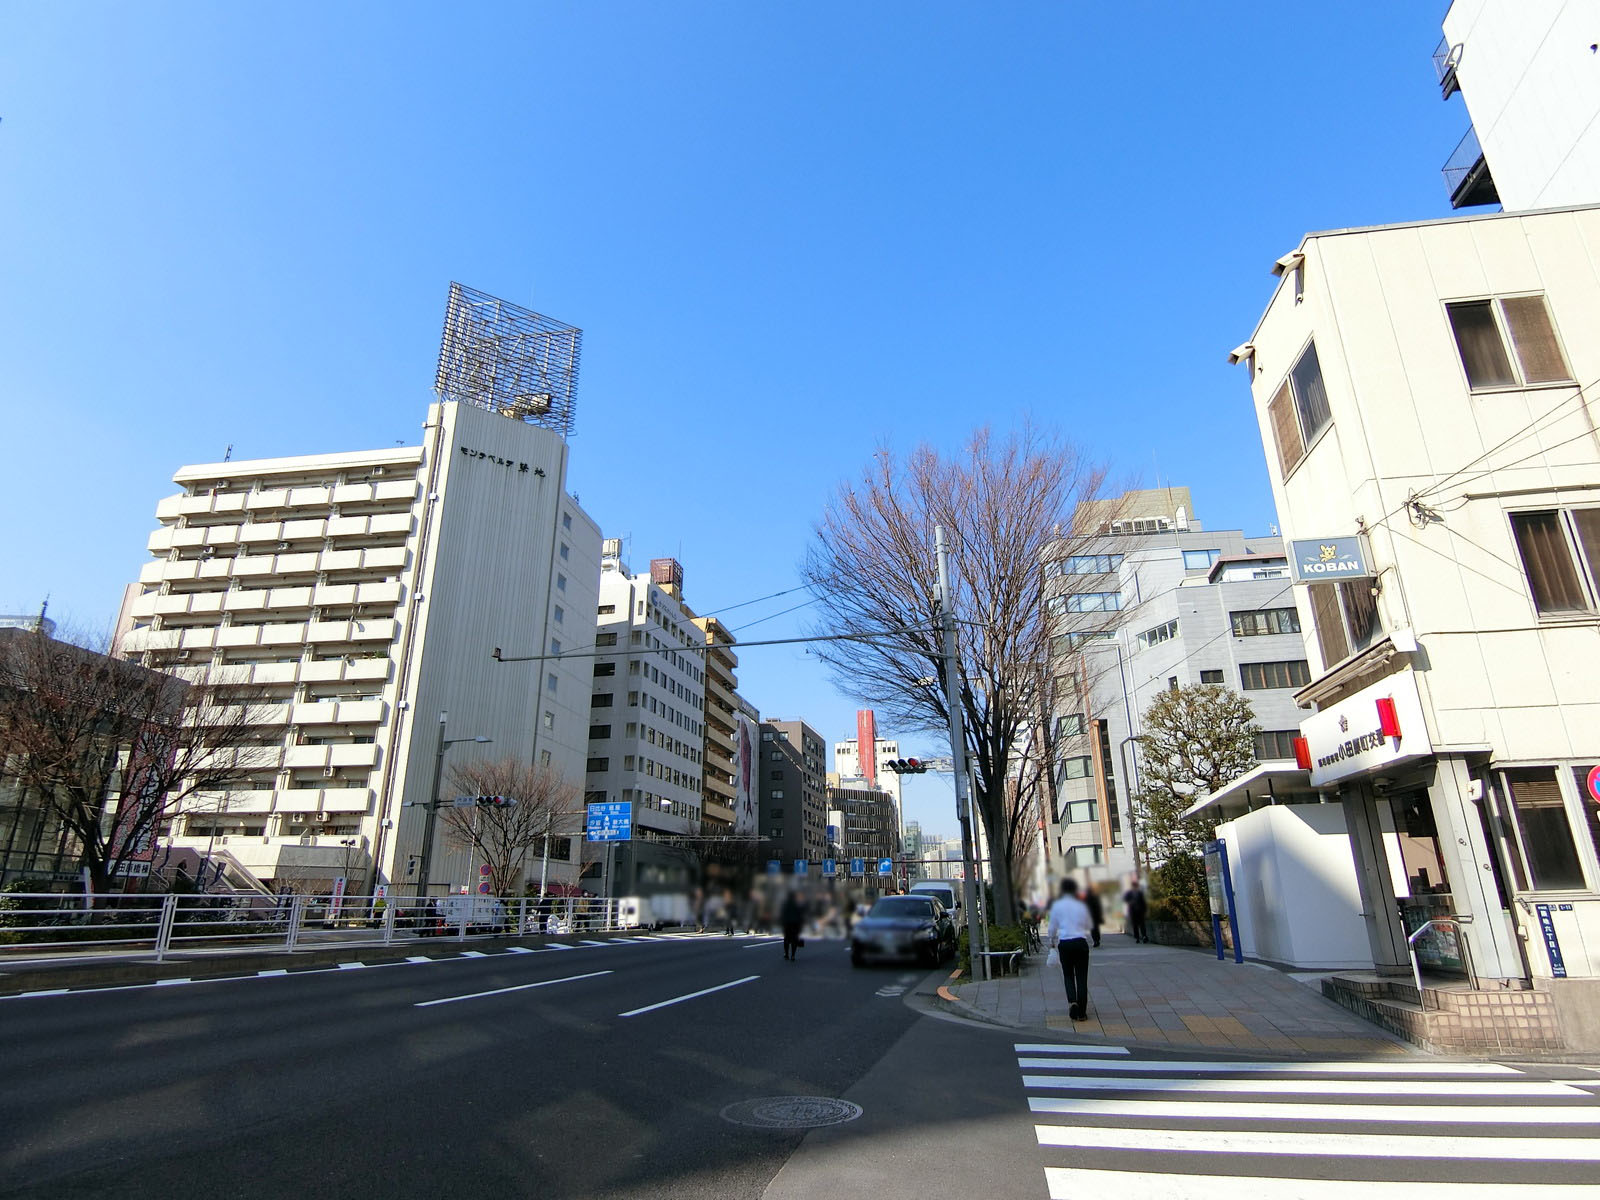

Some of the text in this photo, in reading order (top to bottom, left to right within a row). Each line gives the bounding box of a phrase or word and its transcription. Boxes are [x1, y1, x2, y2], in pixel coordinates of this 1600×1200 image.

[1303, 560, 1359, 573] KOBAN
[109, 863, 149, 874] 田原橋棟
